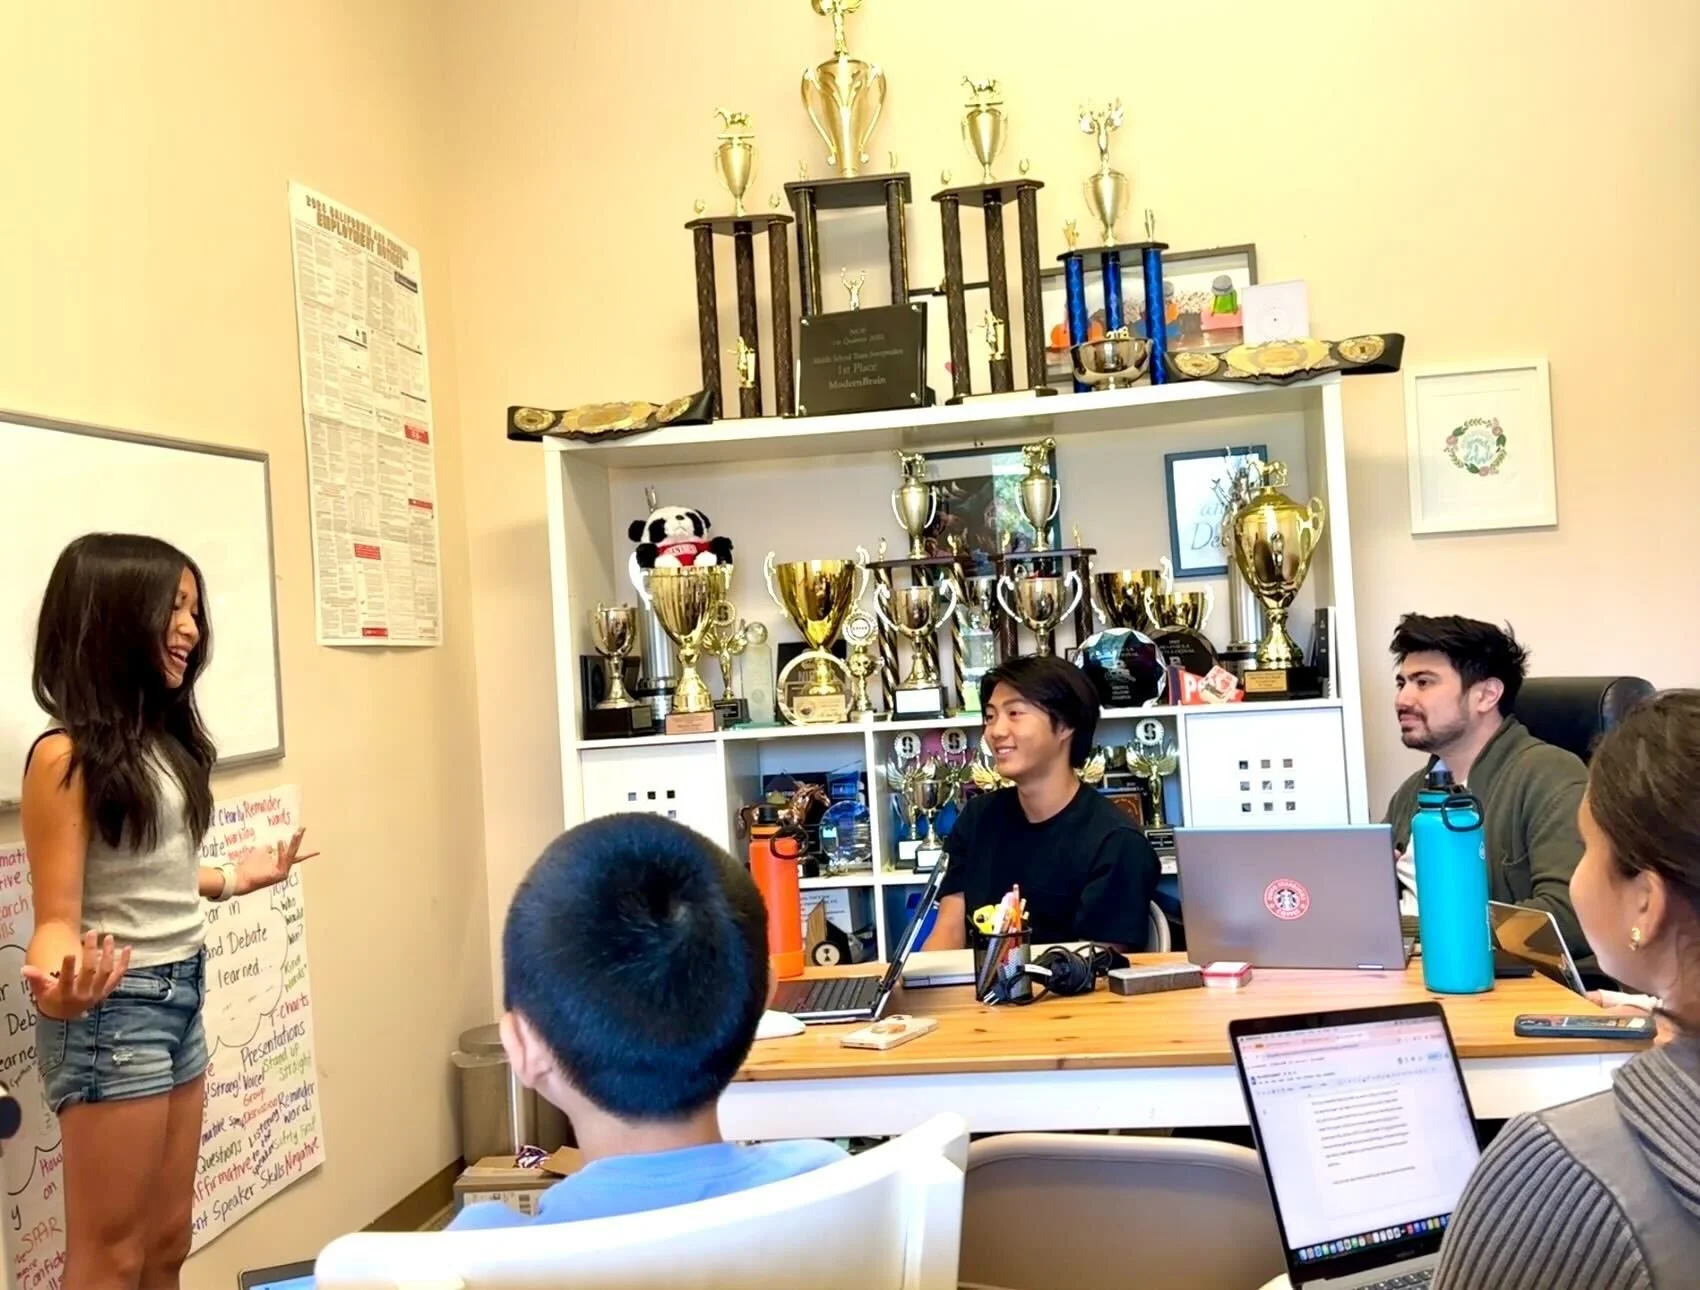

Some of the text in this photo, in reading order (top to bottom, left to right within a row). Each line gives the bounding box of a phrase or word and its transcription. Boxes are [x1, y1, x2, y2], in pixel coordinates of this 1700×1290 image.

[316, 210, 375, 253] EMPLOYMENT
[229, 900, 241, 917] in
[227, 921, 268, 955] Debate
[240, 1020, 306, 1073] Presentations
[212, 1183, 256, 1223] Speaker
